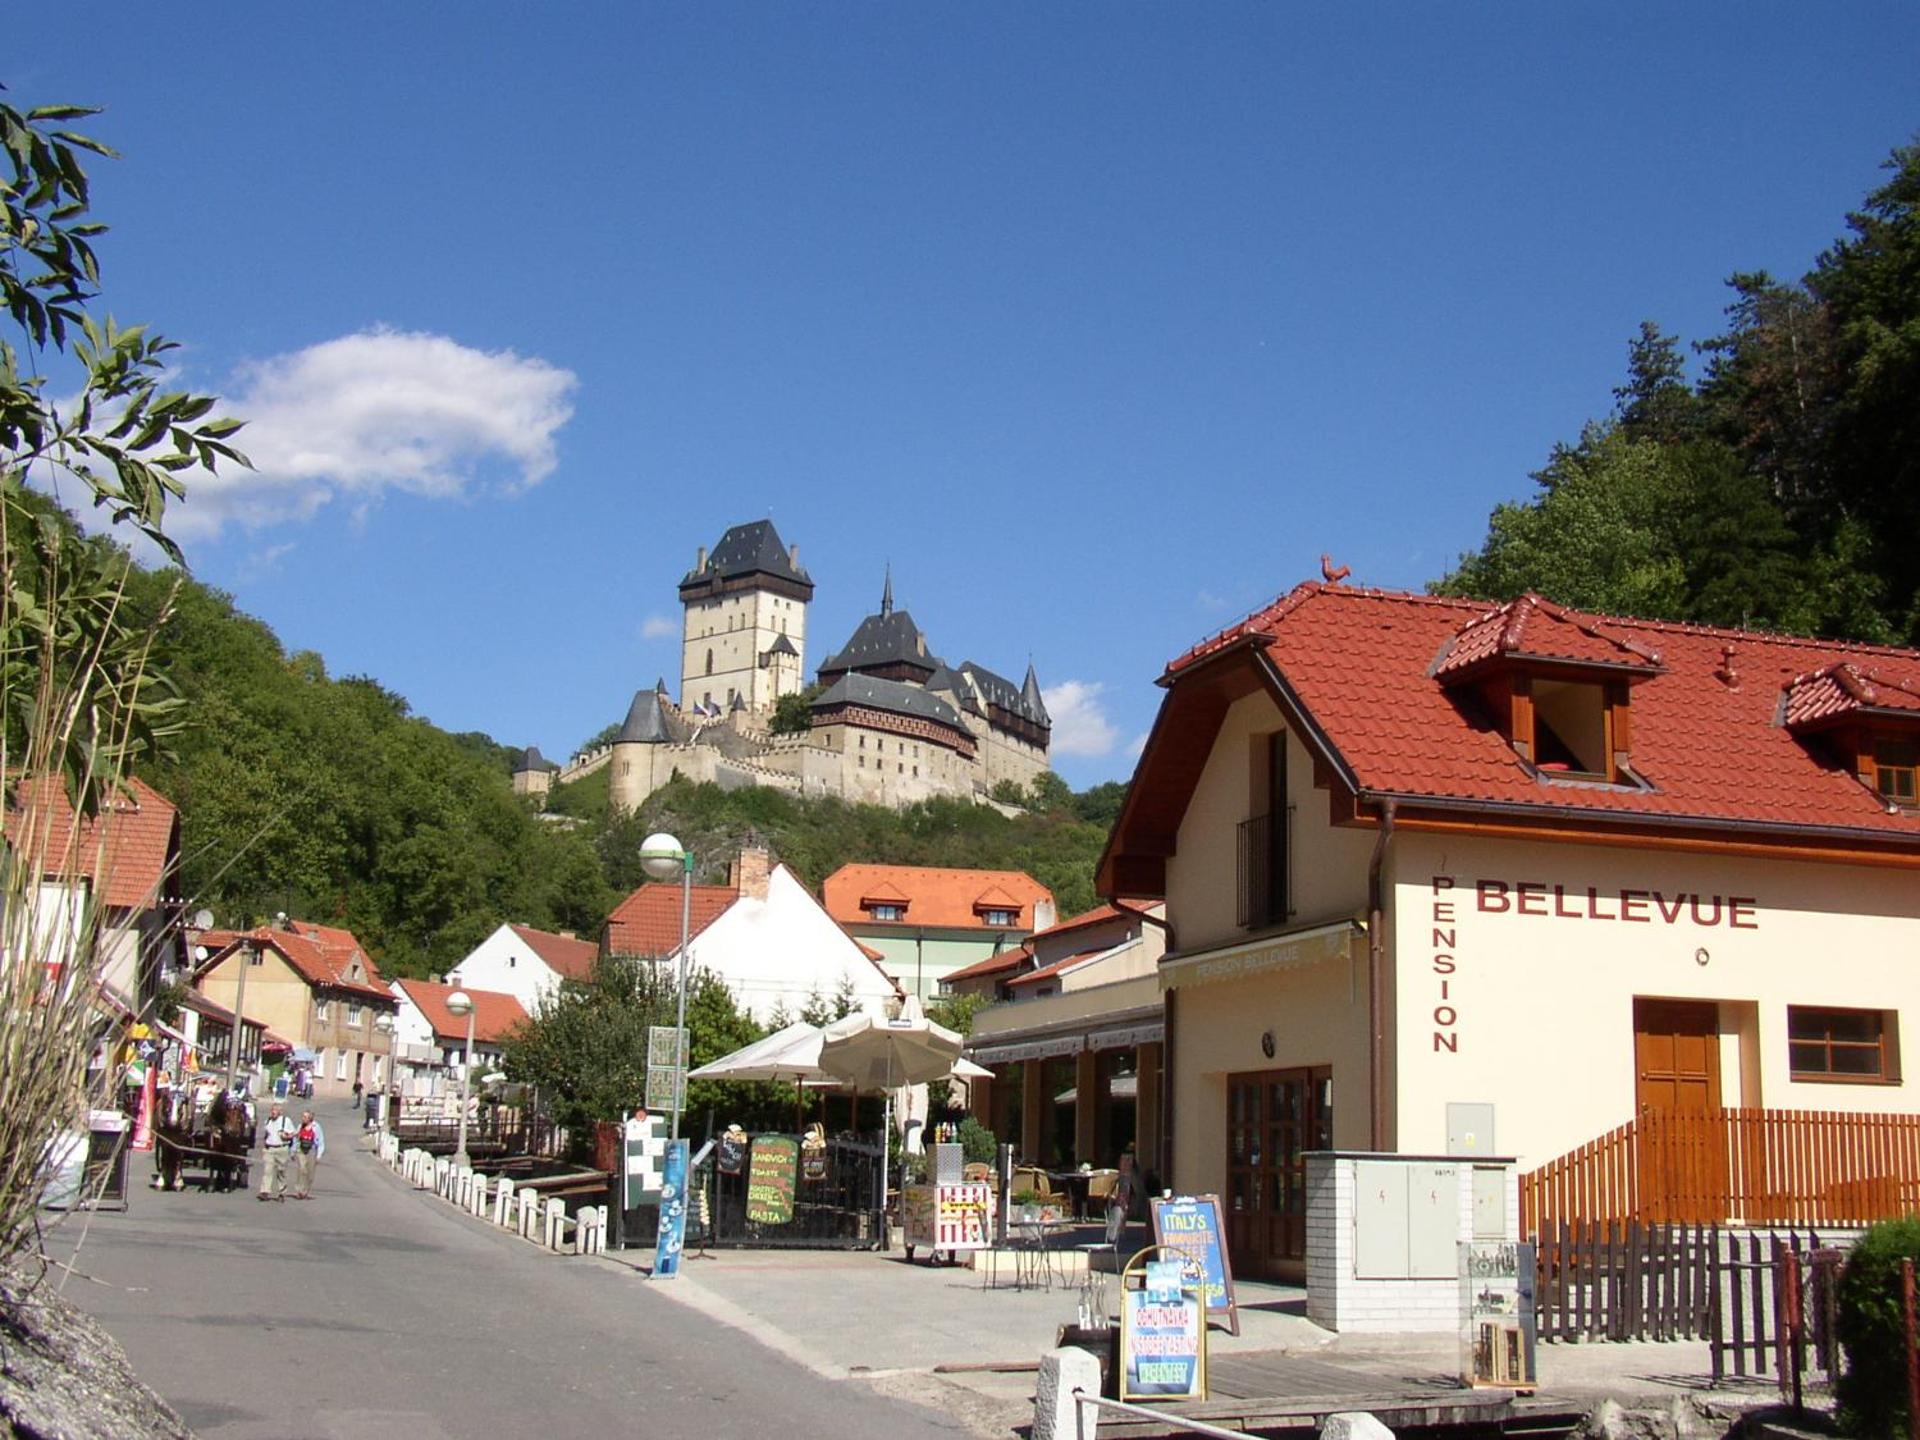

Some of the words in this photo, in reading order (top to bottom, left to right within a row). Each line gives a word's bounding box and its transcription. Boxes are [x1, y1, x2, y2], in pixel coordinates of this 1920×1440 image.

[1476, 879, 1759, 930] BELLEVUE
[1198, 958, 1242, 977] PENSION
[1244, 945, 1298, 967] BELLEVUE
[1432, 877, 1457, 1053] PENSION
[750, 1210, 781, 1222] PASTA
